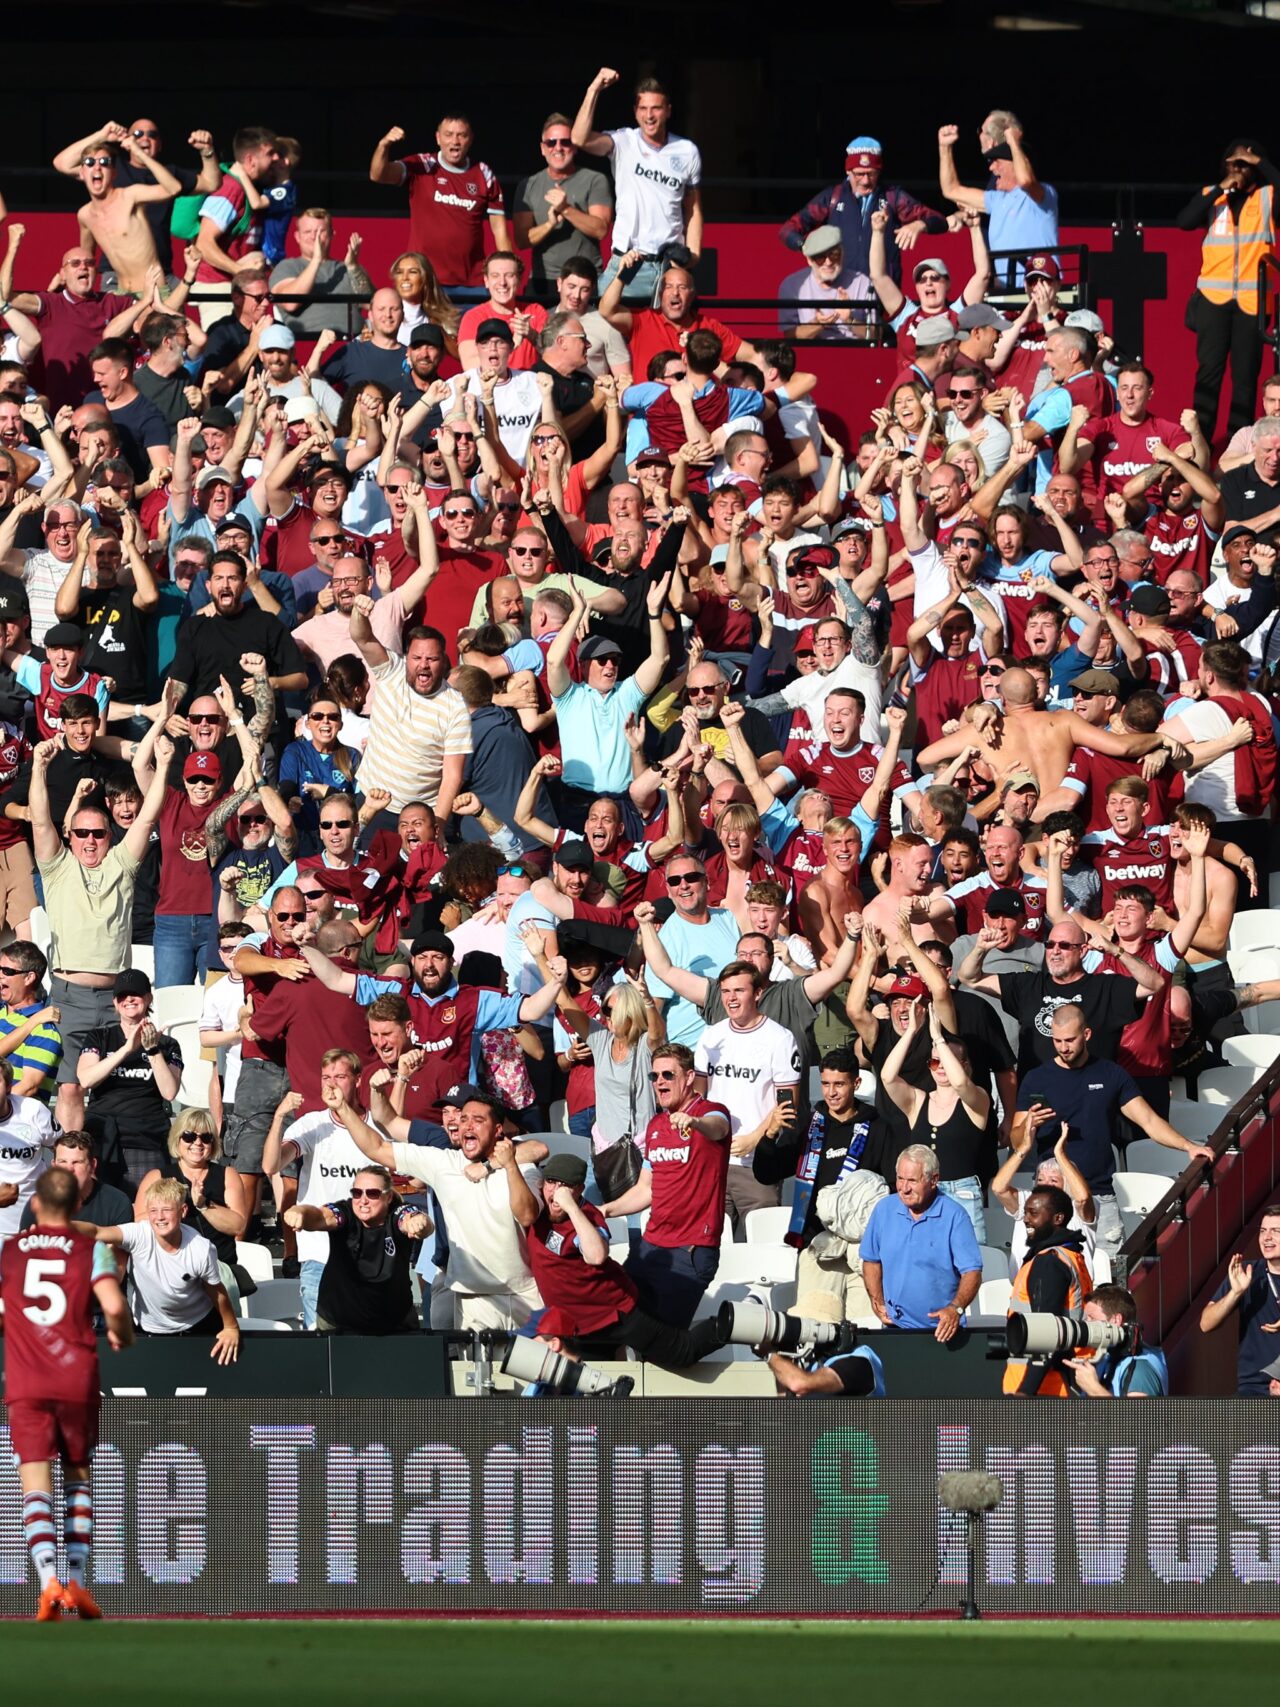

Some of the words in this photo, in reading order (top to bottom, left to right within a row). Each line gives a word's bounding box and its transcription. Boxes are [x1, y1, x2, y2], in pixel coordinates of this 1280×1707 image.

[634, 162, 682, 191] betway
[433, 190, 477, 211] betway
[991, 581, 1037, 601] etway
[1104, 864, 1167, 882] betway
[110, 1066, 154, 1082] etway
[707, 1063, 762, 1083] betway
[17, 1235, 75, 1255] COUFAL
[22, 1258, 67, 1327] 5
[249, 1425, 766, 1601] Trading
[811, 1425, 890, 1585] &
